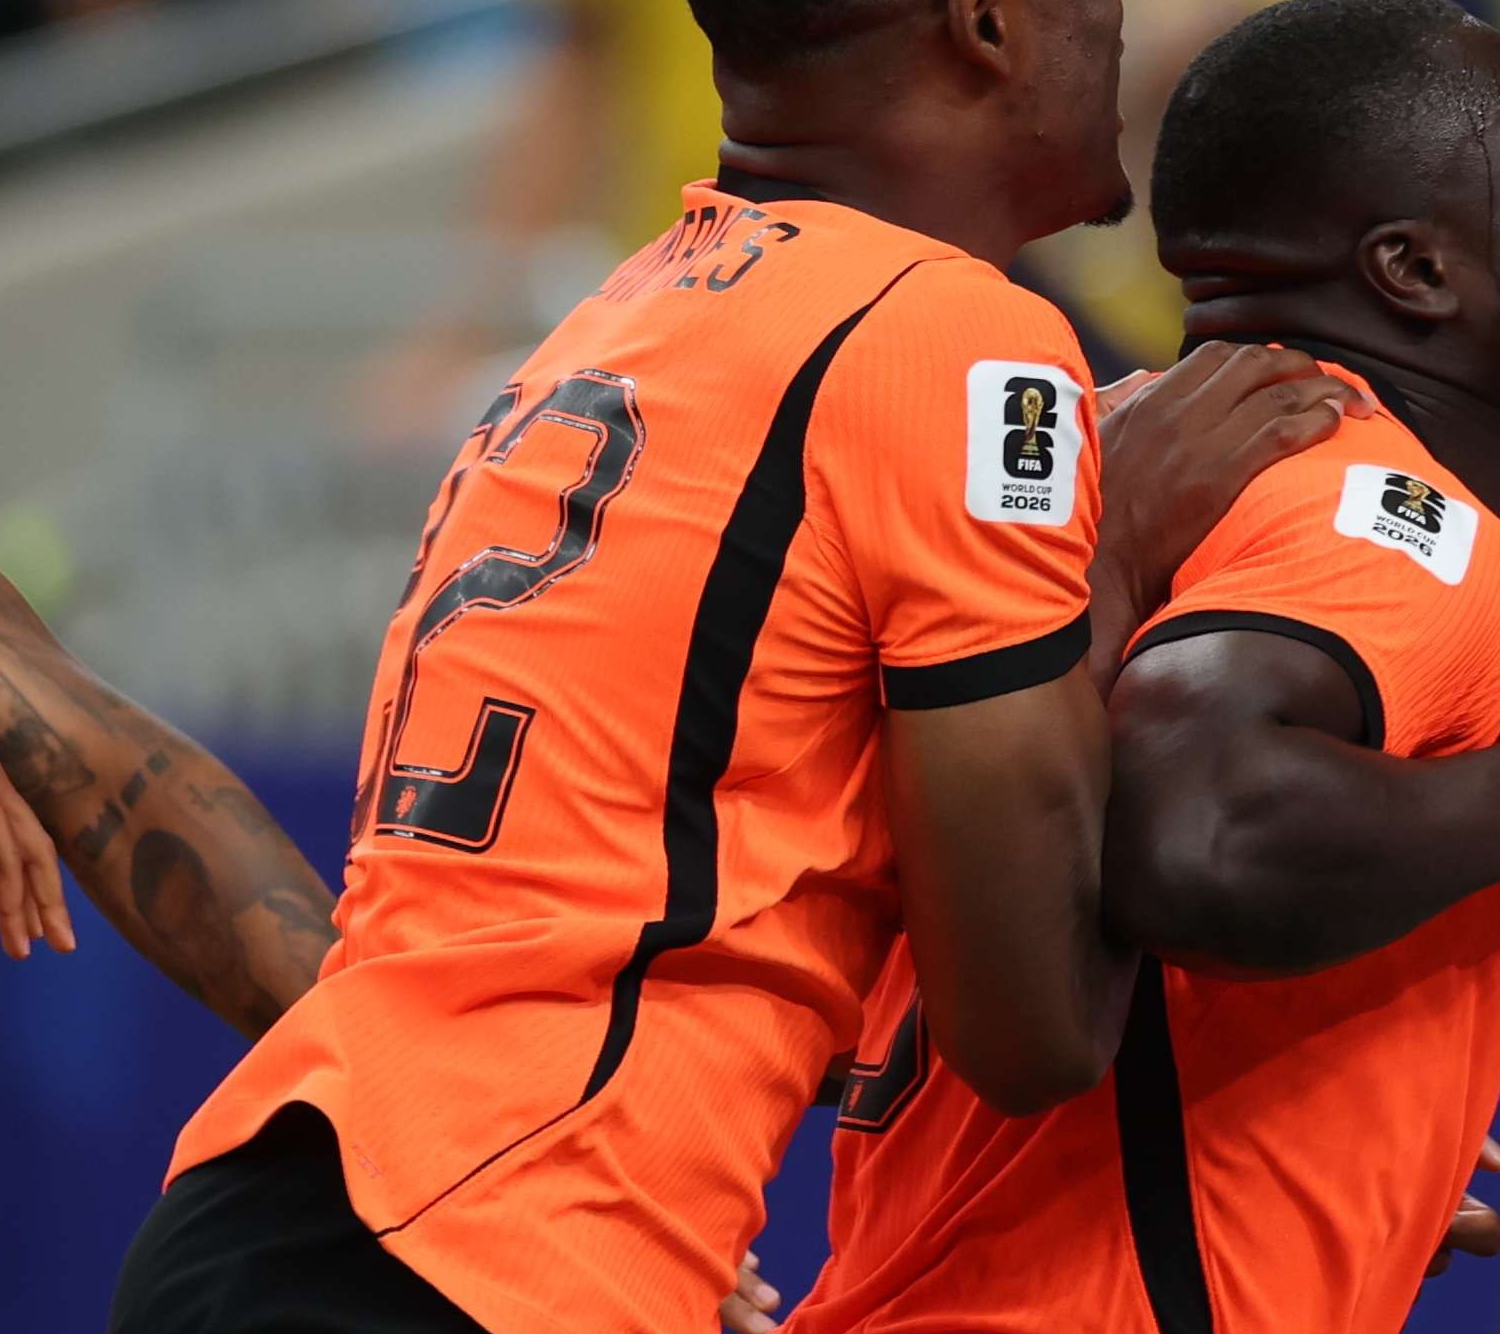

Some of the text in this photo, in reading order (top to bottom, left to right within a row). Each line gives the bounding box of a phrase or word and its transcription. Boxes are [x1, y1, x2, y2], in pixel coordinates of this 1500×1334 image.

[1017, 457, 1043, 473] FIFA
[1002, 483, 1053, 495] WORLD CUP
[1001, 494, 1051, 512] 2026
[1396, 505, 1427, 525] FIFA
[1371, 522, 1433, 558] 2026
[1375, 514, 1437, 547] WORLD CUP
